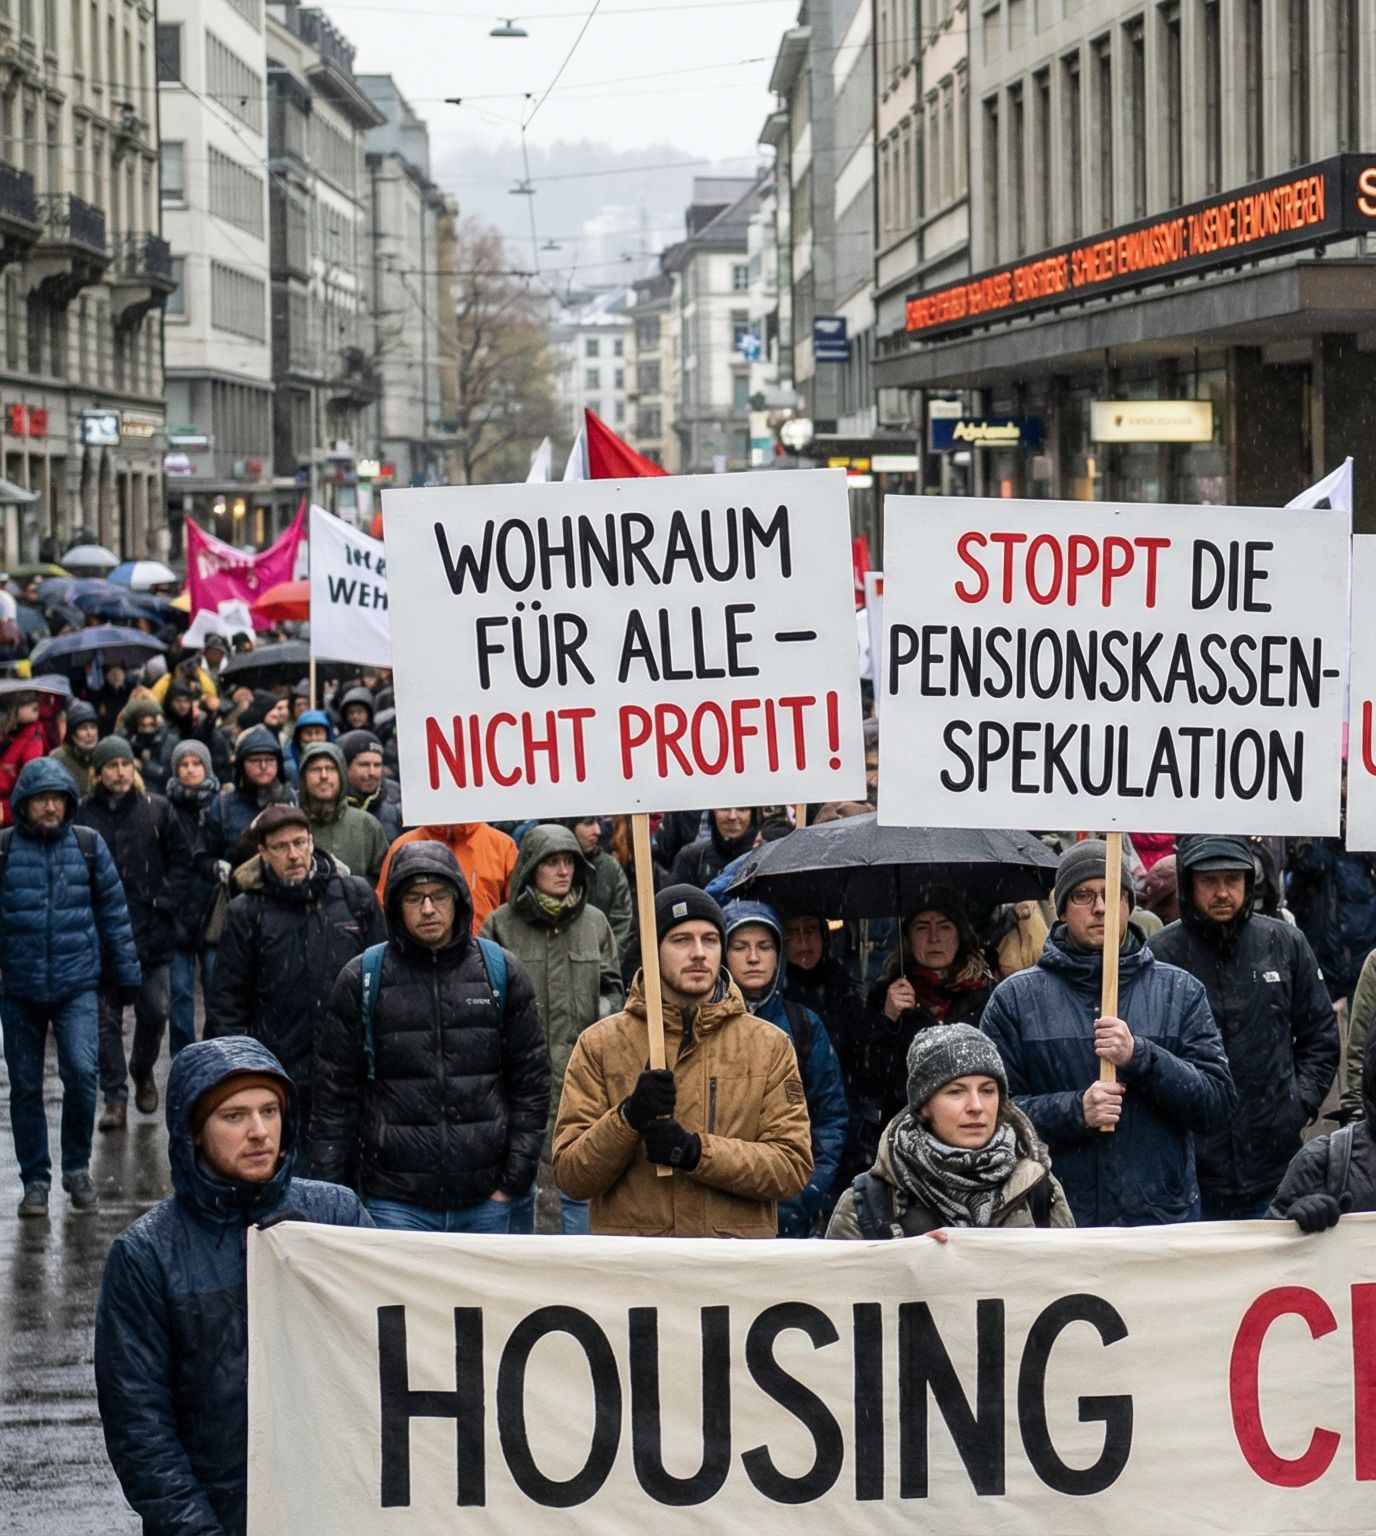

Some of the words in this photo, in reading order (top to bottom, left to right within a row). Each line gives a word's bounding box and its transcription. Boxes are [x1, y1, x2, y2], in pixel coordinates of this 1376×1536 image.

[434, 504, 792, 595] WOHNRAUM
[954, 531, 1172, 609] STOPPT
[1191, 539, 1274, 613] DIE
[475, 600, 595, 690] FÜR
[618, 604, 757, 683] ALLE
[889, 623, 1340, 710] PENSIONSKASSEN-
[425, 707, 597, 790] NICHT
[618, 690, 842, 781] PROFIT!
[940, 719, 1304, 803] SPEKULATION
[376, 1293, 1134, 1509] HOUSING
